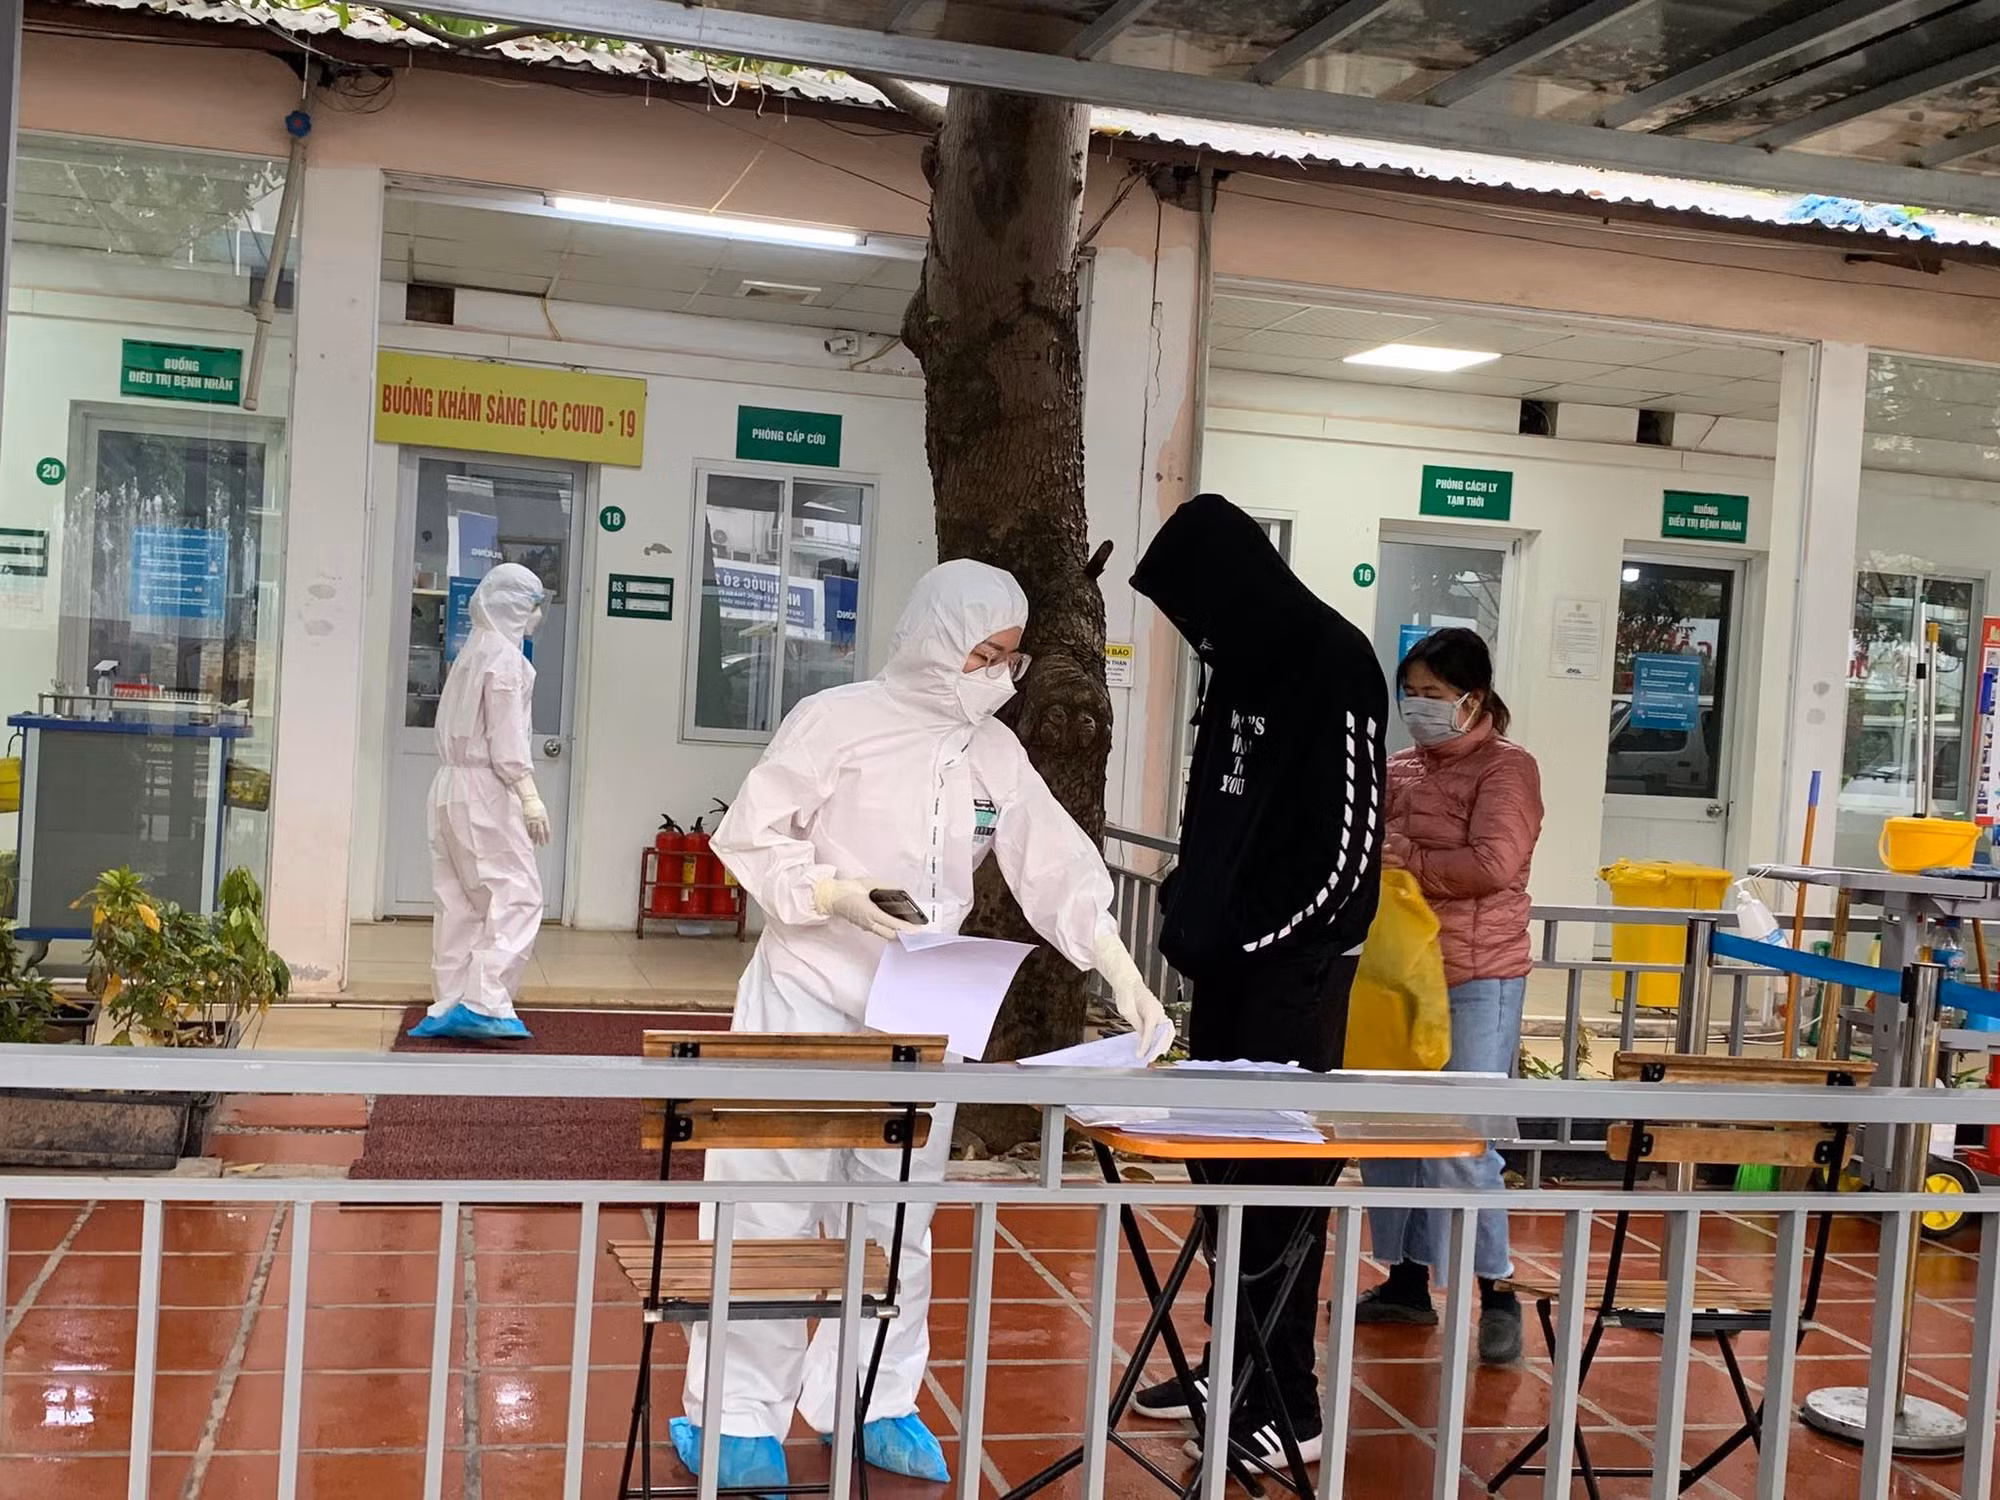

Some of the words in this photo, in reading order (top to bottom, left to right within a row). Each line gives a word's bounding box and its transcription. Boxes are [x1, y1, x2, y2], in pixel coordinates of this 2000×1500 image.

[155, 373, 171, 388] TRỊ
[174, 374, 202, 389] BỆNH
[203, 377, 233, 391] NHÂN
[438, 385, 482, 422] KHÁM
[486, 389, 526, 426] SÀNG
[530, 399, 558, 435] LỌC
[562, 402, 604, 434] COVID
[619, 409, 636, 438] 19
[752, 427, 784, 441] PHÒNG
[786, 429, 805, 443] CẤP
[807, 432, 826, 445] CỨU
[42, 463, 60, 479] 20
[1435, 477, 1463, 491] PHÒNG
[1465, 480, 1487, 492] CÁCH
[1488, 482, 1498, 493] LY
[1447, 495, 1465, 507] TẠM
[1466, 495, 1485, 507] THỜI
[605, 511, 621, 526] 18
[1687, 517, 1699, 530] TRỊ
[1699, 516, 1720, 531] BỆNH
[1720, 520, 1742, 531] NHÂN
[1358, 568, 1372, 582] 16
[1219, 774, 1246, 796] YOU
